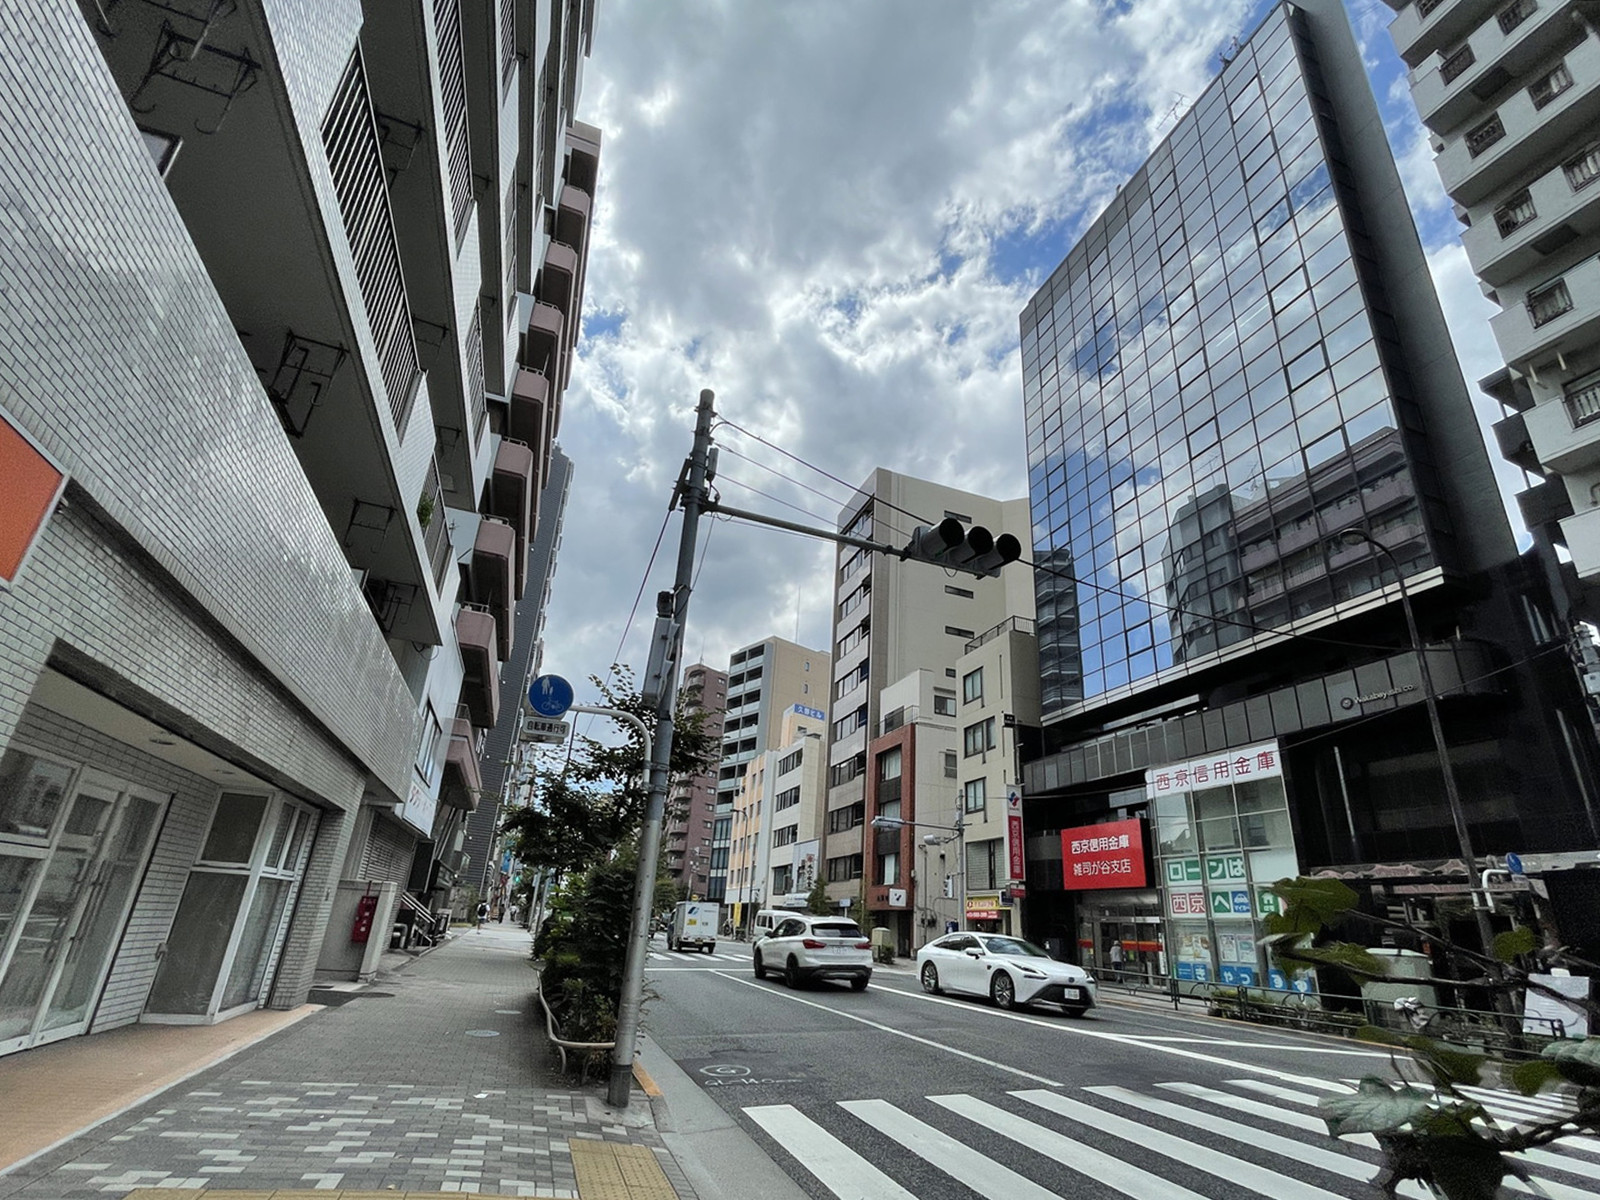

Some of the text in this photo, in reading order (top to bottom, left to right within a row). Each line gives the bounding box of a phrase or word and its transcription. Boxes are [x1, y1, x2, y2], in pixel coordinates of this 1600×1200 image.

[1156, 751, 1275, 791] 西京信用金庫
[1071, 834, 1130, 855] 西京信用金庫
[1073, 860, 1131, 877] 雑司が谷支店
[1169, 859, 1246, 880] ローンは
